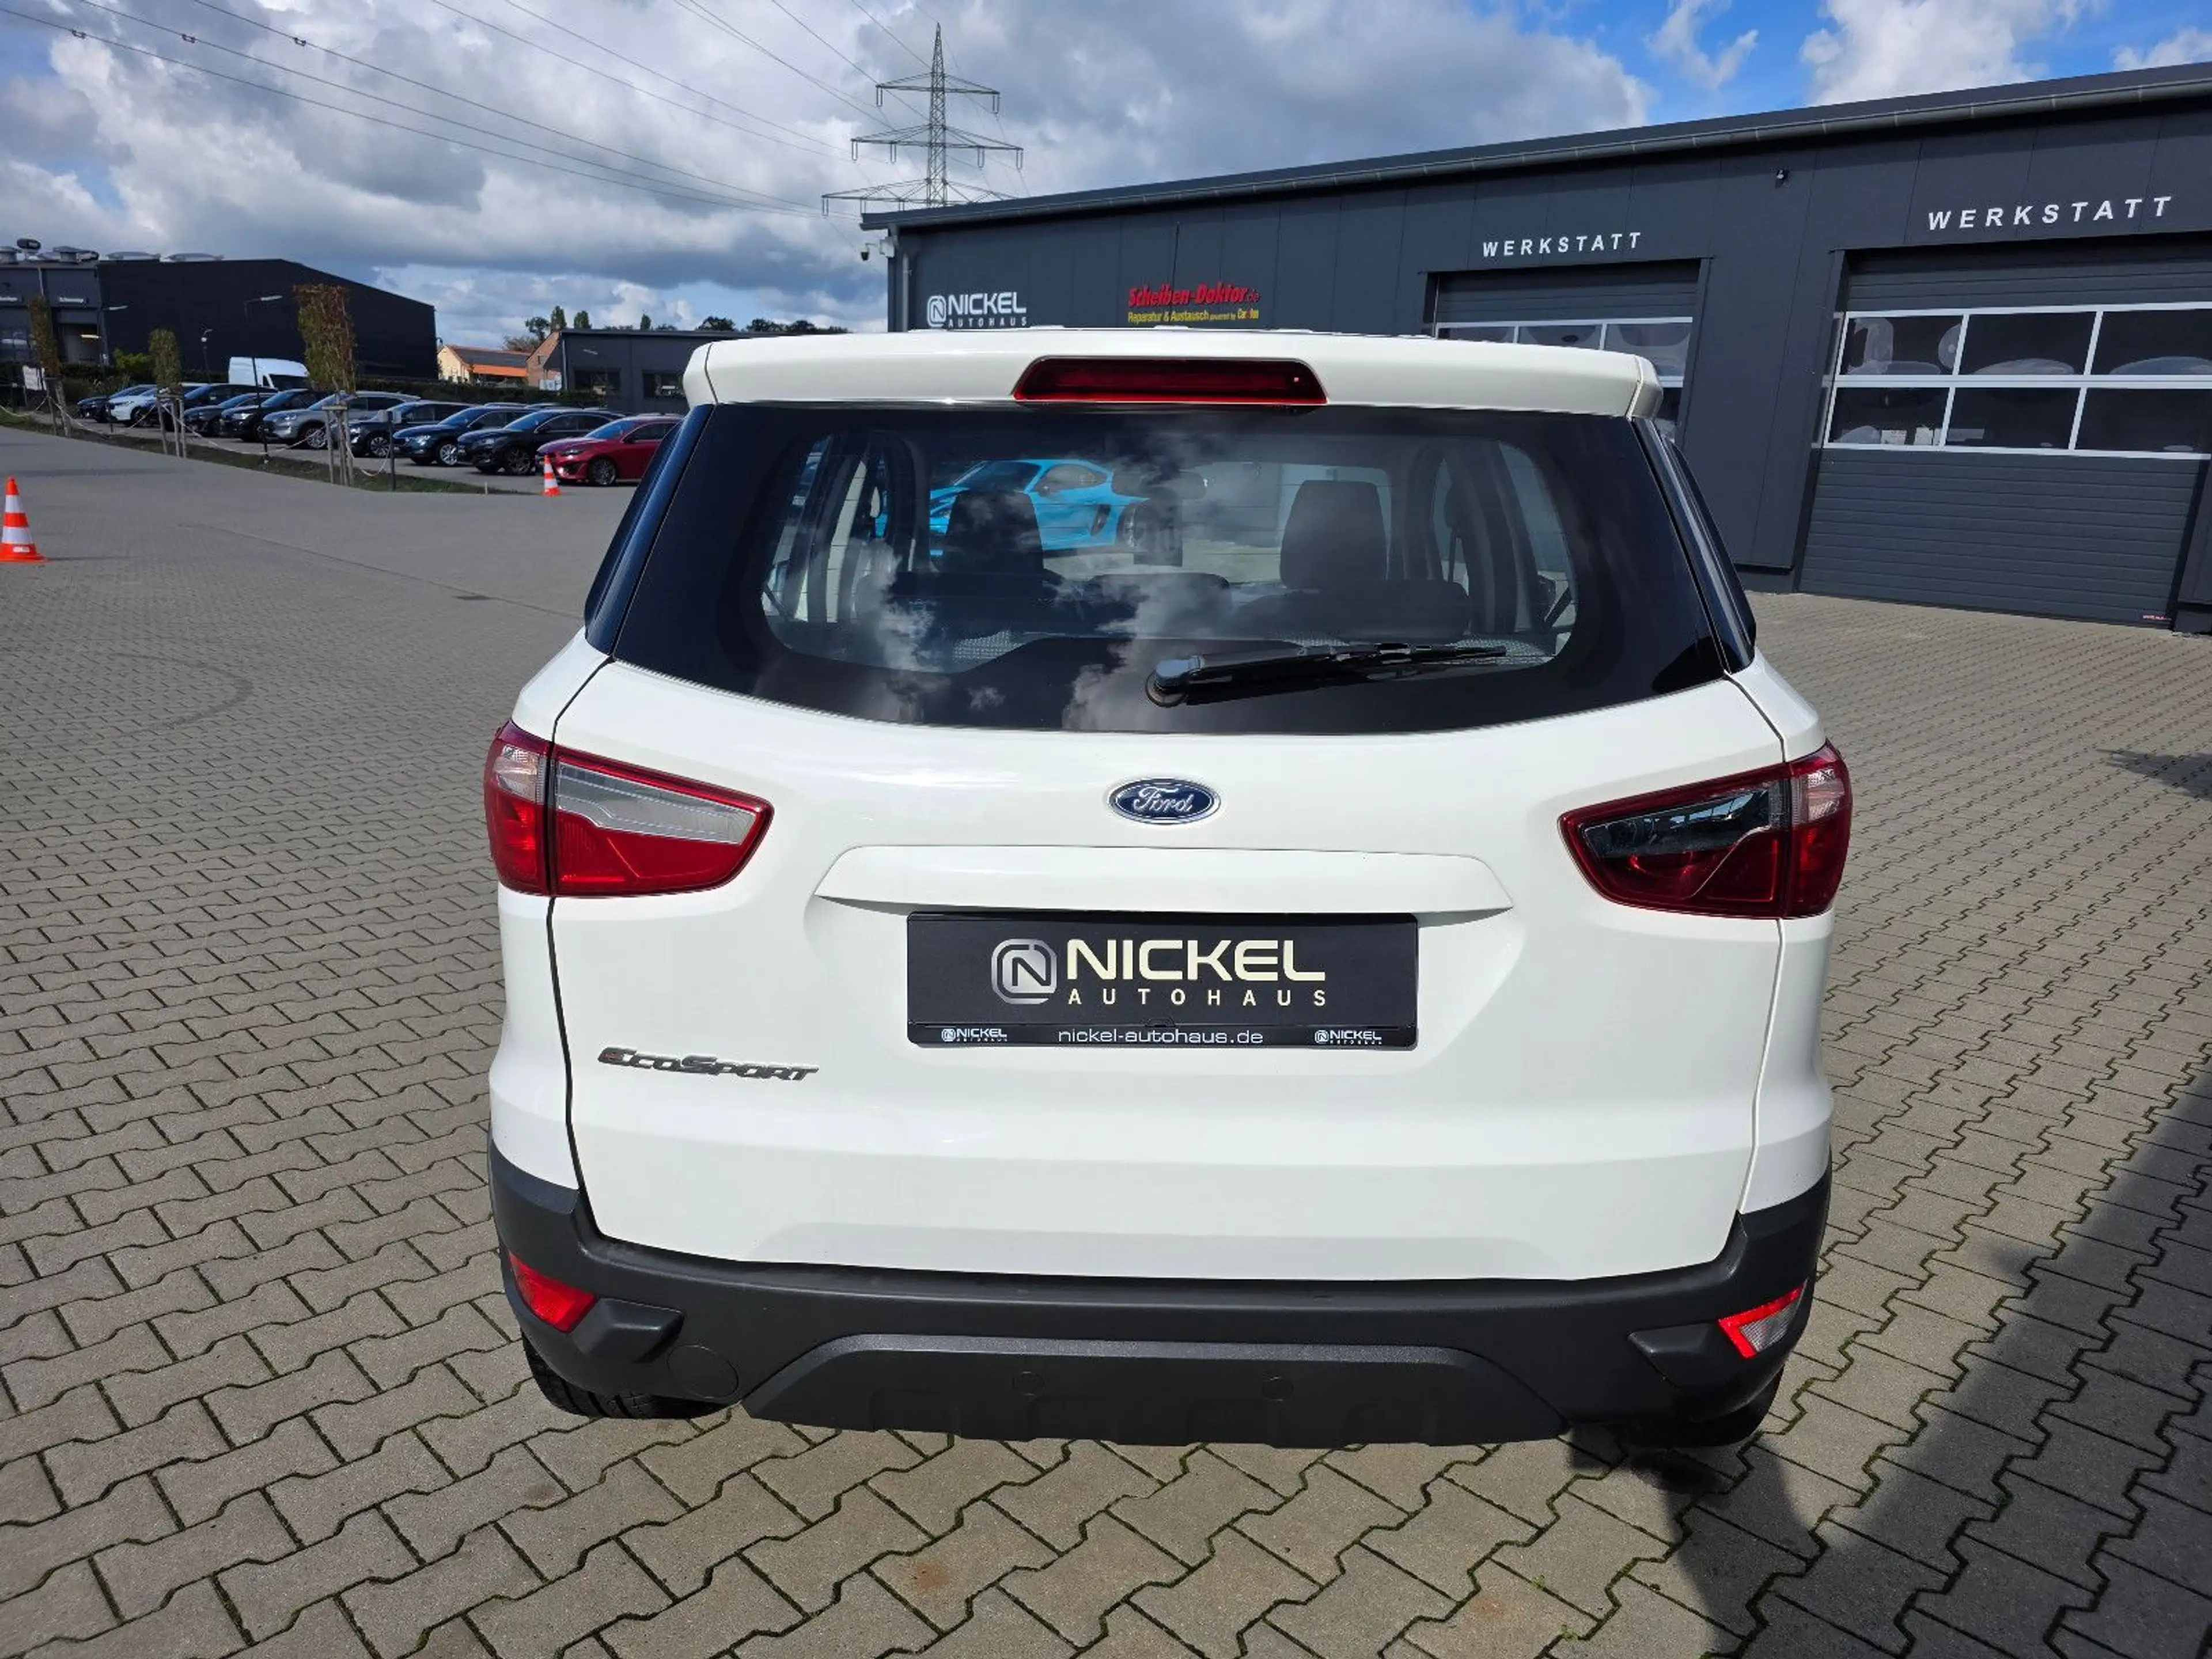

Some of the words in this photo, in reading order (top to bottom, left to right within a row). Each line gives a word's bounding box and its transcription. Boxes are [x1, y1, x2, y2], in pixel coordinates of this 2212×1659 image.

[1928, 196, 2171, 230] WERKSTATT
[1483, 232, 1641, 257] WERKSTATT
[948, 291, 1027, 316] NICKEL
[948, 317, 1028, 328] AUTOHAUS
[1133, 786, 1194, 813] Ford
[1067, 938, 1325, 981] NICKEL
[1068, 988, 1325, 1006] AUTOHAUS
[956, 1028, 1007, 1037] NICKEL
[1058, 1028, 1263, 1044] nickel-autohaus.de
[1330, 1030, 1382, 1040] NICKEL
